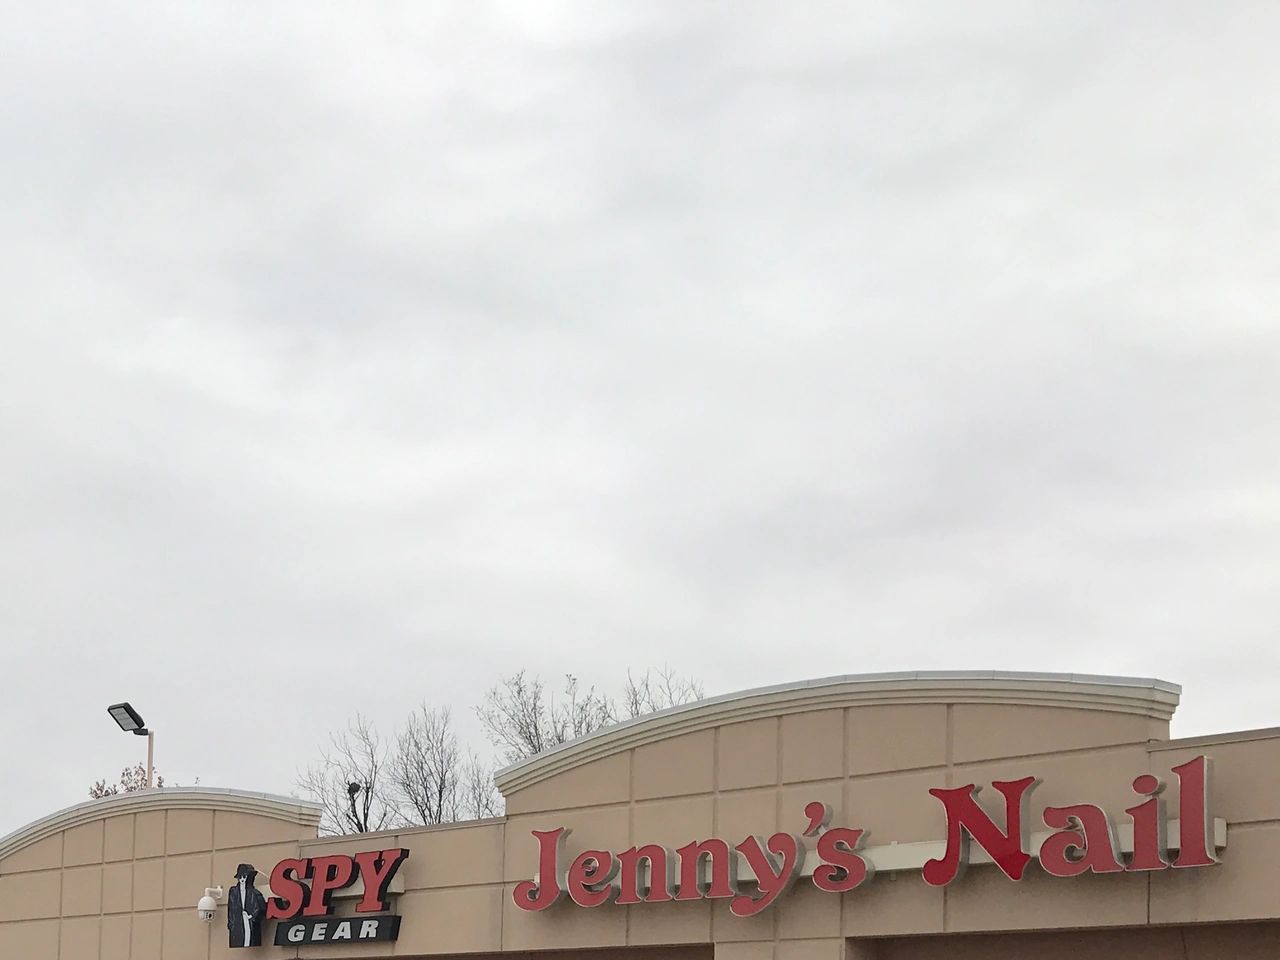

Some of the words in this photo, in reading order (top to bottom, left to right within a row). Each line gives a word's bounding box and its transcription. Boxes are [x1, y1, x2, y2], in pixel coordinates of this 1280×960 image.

[512, 801, 867, 917] Jenny's
[921, 755, 1217, 887] Nail
[265, 848, 410, 920] SPY
[287, 920, 379, 942] GEAR
